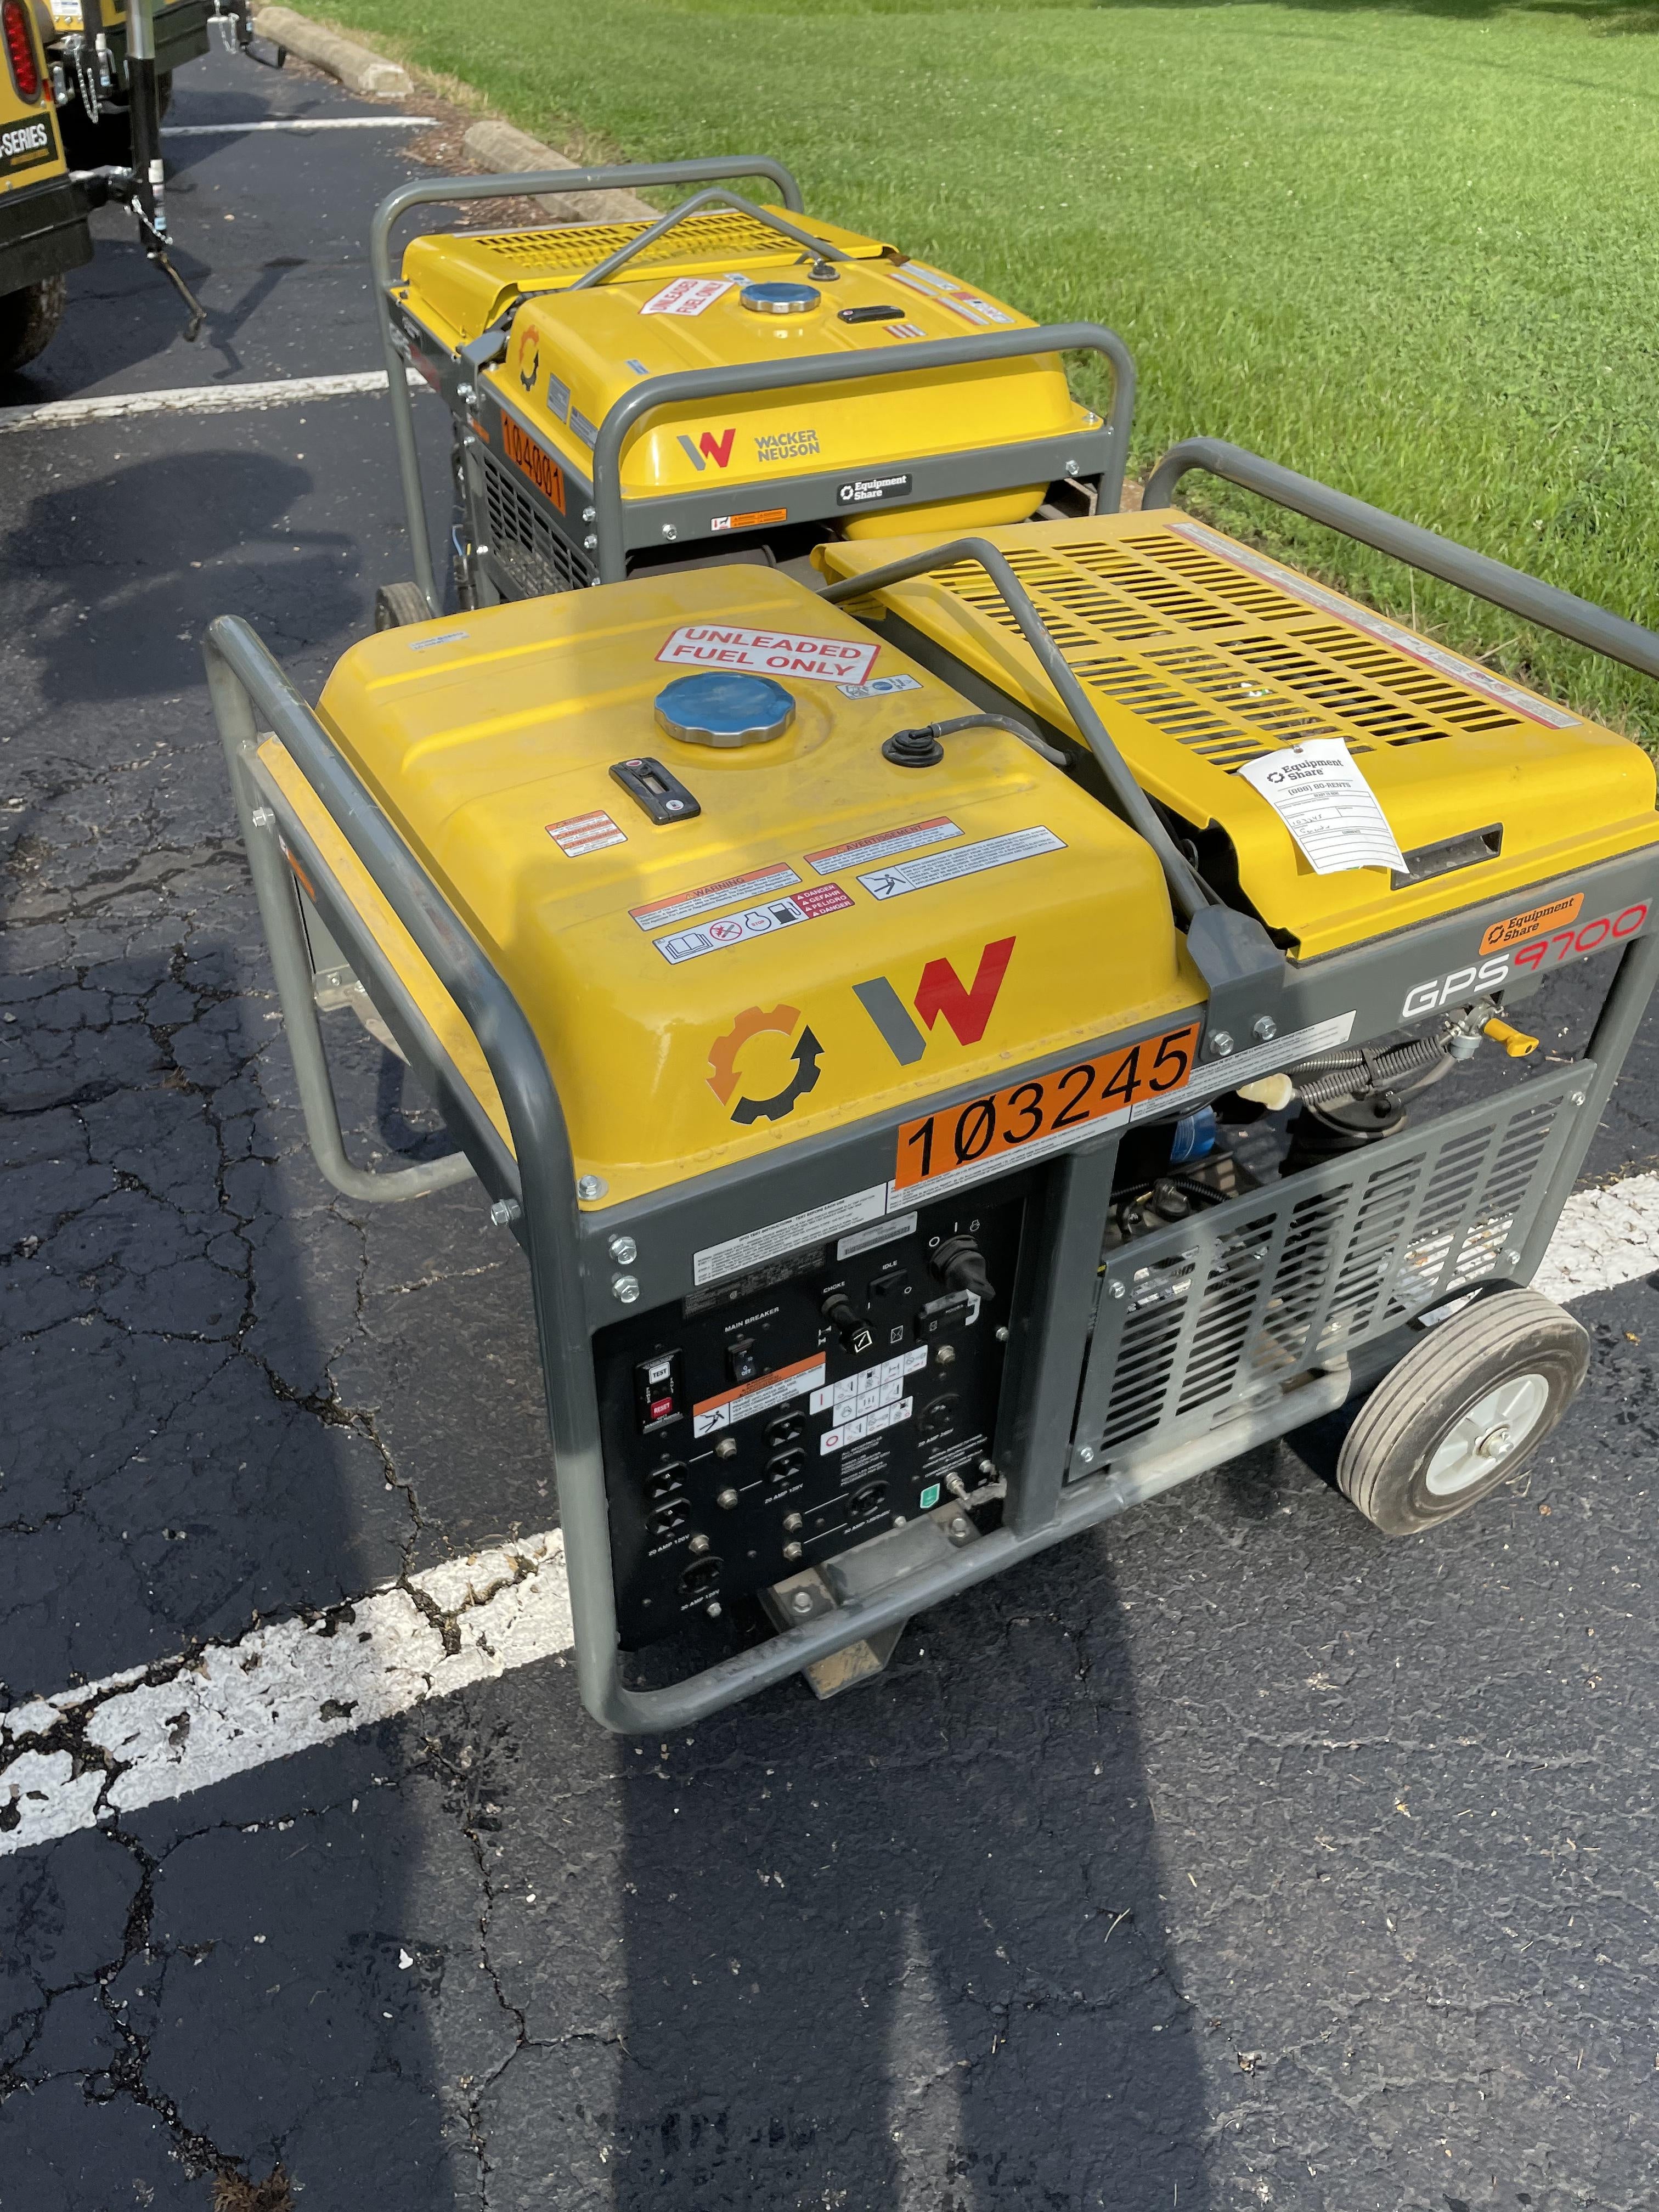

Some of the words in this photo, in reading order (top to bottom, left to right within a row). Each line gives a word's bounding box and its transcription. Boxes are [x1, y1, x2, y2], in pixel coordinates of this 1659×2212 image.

[754, 430, 819, 449] WACKER
[758, 442, 820, 462] NEUSON
[854, 475, 907, 491] Equipment
[854, 489, 883, 500] Share
[684, 628, 862, 659] UNLEADED
[673, 645, 754, 664] FUEL
[766, 656, 856, 676] ONLY
[1281, 759, 1344, 774] Equipment
[1288, 769, 1324, 781] Share
[845, 825, 923, 851] AVERTISSEMENT
[693, 877, 745, 898] WARNING
[804, 885, 835, 898] DANGER
[809, 890, 840, 902] GEFAHR
[812, 895, 847, 909] PELIGRO
[819, 901, 851, 913] DANGER
[1507, 898, 1575, 930] Equipment
[1503, 922, 1540, 941] Share
[1402, 953, 1509, 1018] GPS
[1515, 904, 1647, 970] 9700
[908, 1029, 1193, 1177] 103245
[882, 1260, 898, 1270] IDLE
[823, 1281, 845, 1293] CHOKE
[725, 1321, 743, 1332] MAIN
[745, 1307, 779, 1324] BREAKER
[652, 1368, 667, 1378] TEST
[653, 1402, 670, 1413] RESET
[658, 1542, 673, 1552] AMP
